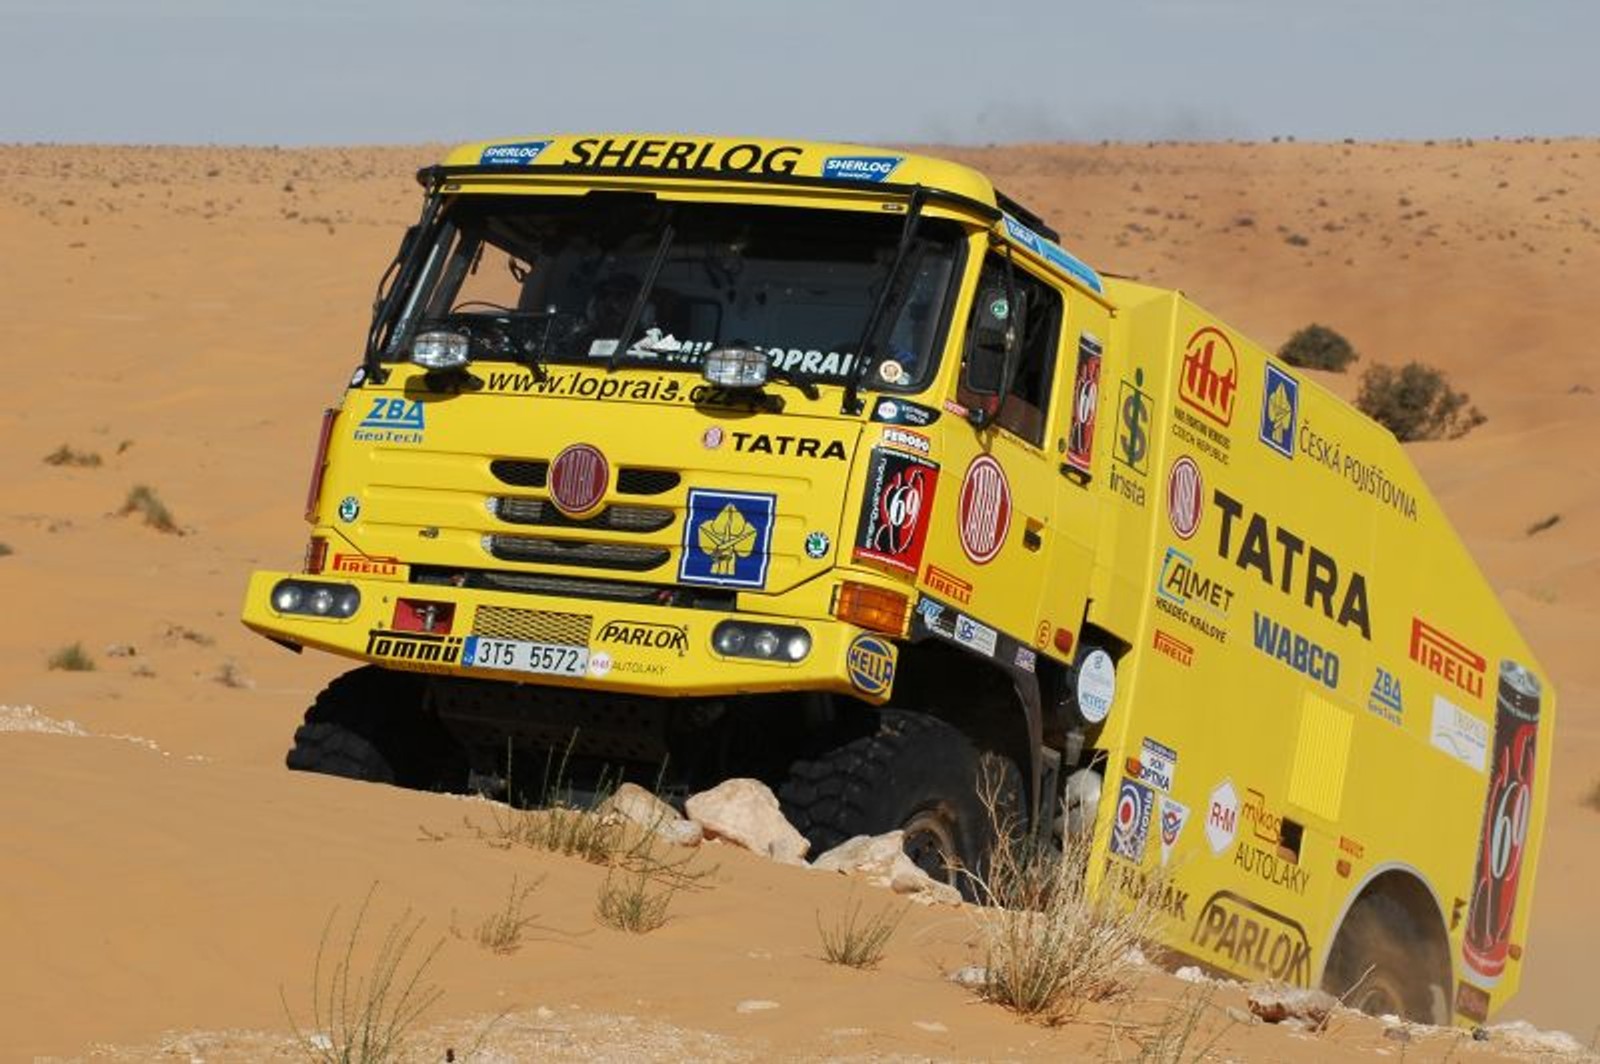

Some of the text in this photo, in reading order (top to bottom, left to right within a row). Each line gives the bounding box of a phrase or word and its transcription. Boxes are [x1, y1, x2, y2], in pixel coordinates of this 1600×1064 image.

[484, 145, 539, 159] SHERLOG
[564, 139, 803, 175] SHERLOG
[826, 158, 891, 173] SHERLOG
[754, 346, 871, 376] OPRAI
[354, 430, 424, 443] GeoTech
[731, 432, 847, 461] TATRA
[1300, 419, 1341, 474] ČESKÁ
[1110, 464, 1146, 507] insta
[332, 554, 399, 575] PIRELLI
[1213, 488, 1372, 641] TATRA
[924, 564, 973, 605] PIRELLI
[1167, 563, 1235, 612] ALMET
[1156, 597, 1189, 623] HRADEC
[602, 625, 685, 651] PARLOK
[1153, 629, 1194, 668] PIRELLI
[1254, 610, 1340, 689] WABCO
[478, 642, 578, 672] 3T5 5572
[849, 648, 892, 686] HELLA
[1409, 616, 1487, 700] PIRELLI
[1210, 802, 1236, 833] R-M
[1234, 842, 1310, 896] AUTOLAKY
[1201, 903, 1312, 982] PARLOK
